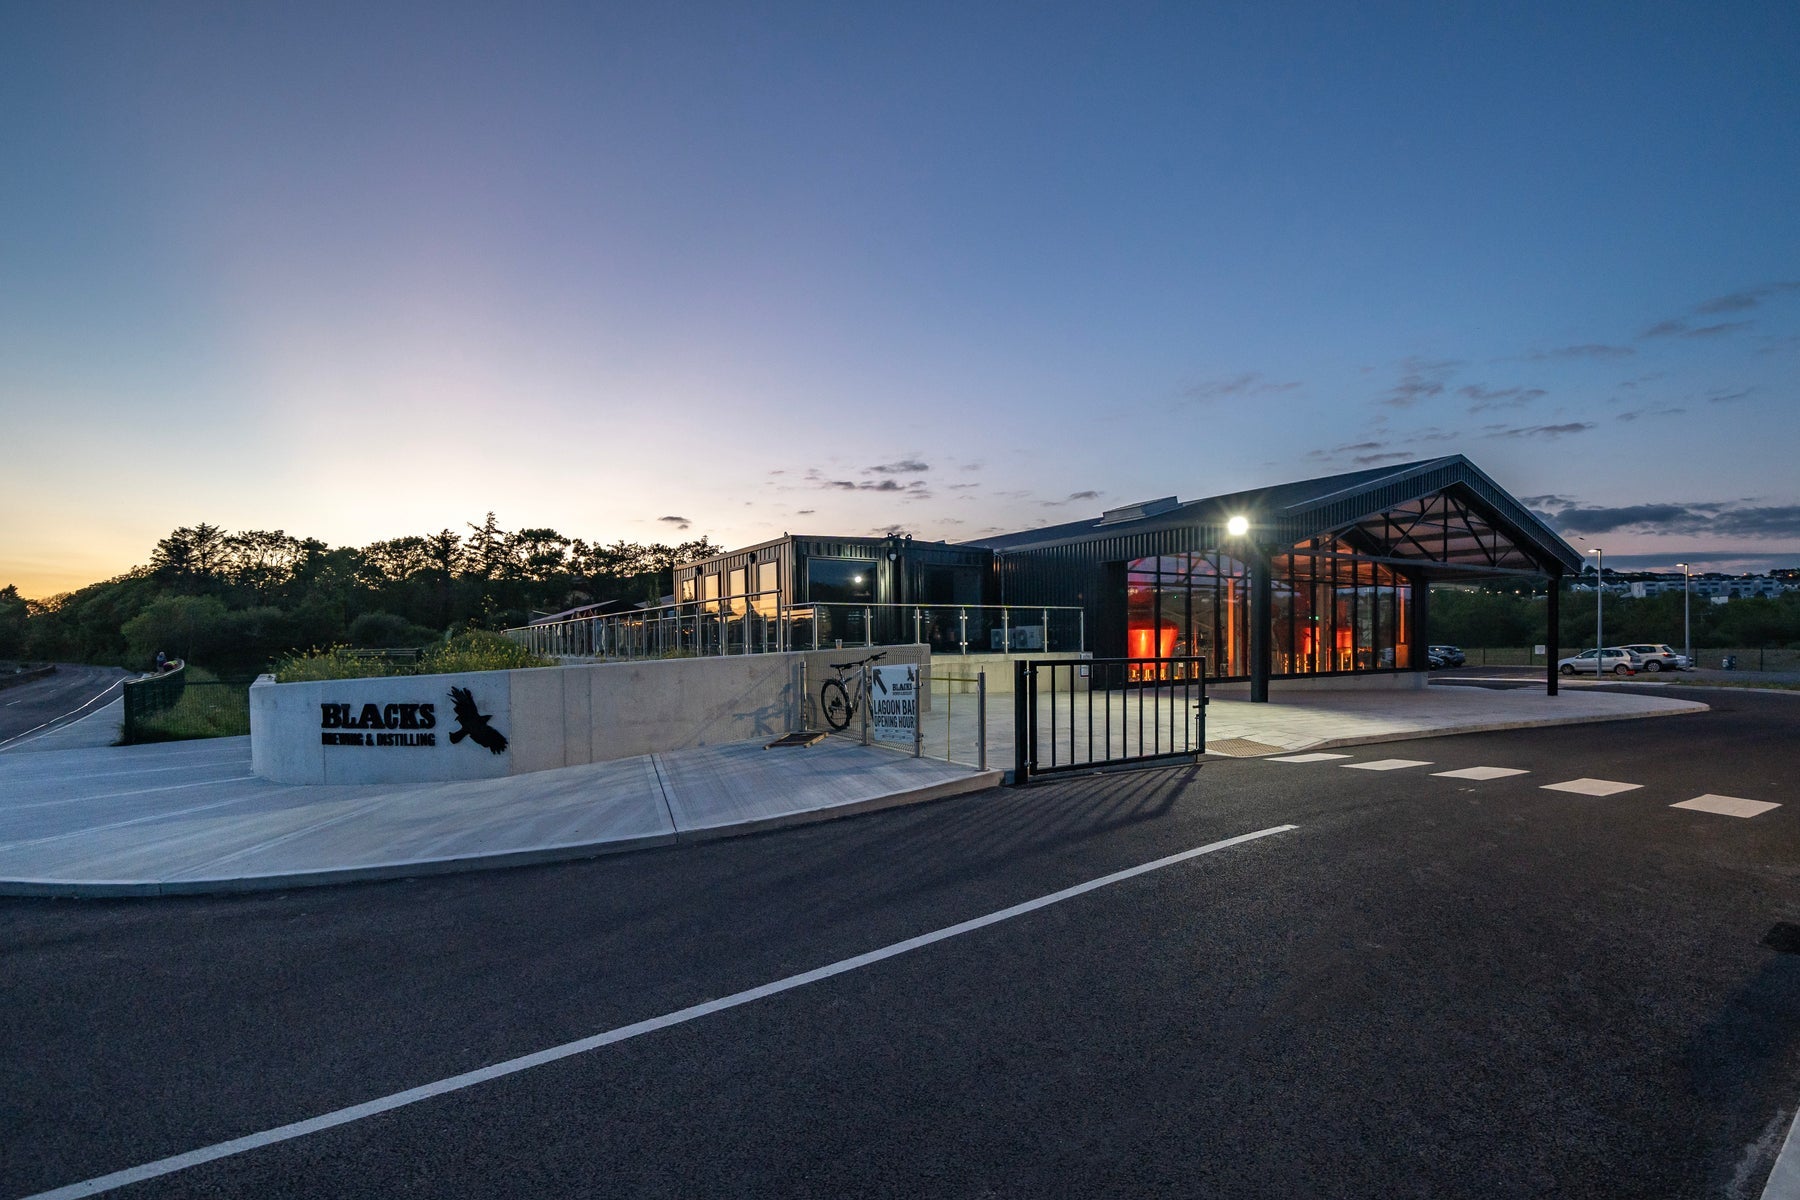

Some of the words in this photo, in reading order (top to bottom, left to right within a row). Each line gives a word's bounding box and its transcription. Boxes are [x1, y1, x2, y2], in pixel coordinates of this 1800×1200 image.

[893, 683, 912, 691] BLACKS
[874, 700, 901, 715] LAGOON
[321, 703, 436, 729] BLACKS
[874, 715, 898, 728] OPENING
[899, 716, 915, 728] HOUR
[321, 733, 364, 746] BREWING
[365, 733, 375, 746] &
[376, 733, 436, 746] DISTILLING
